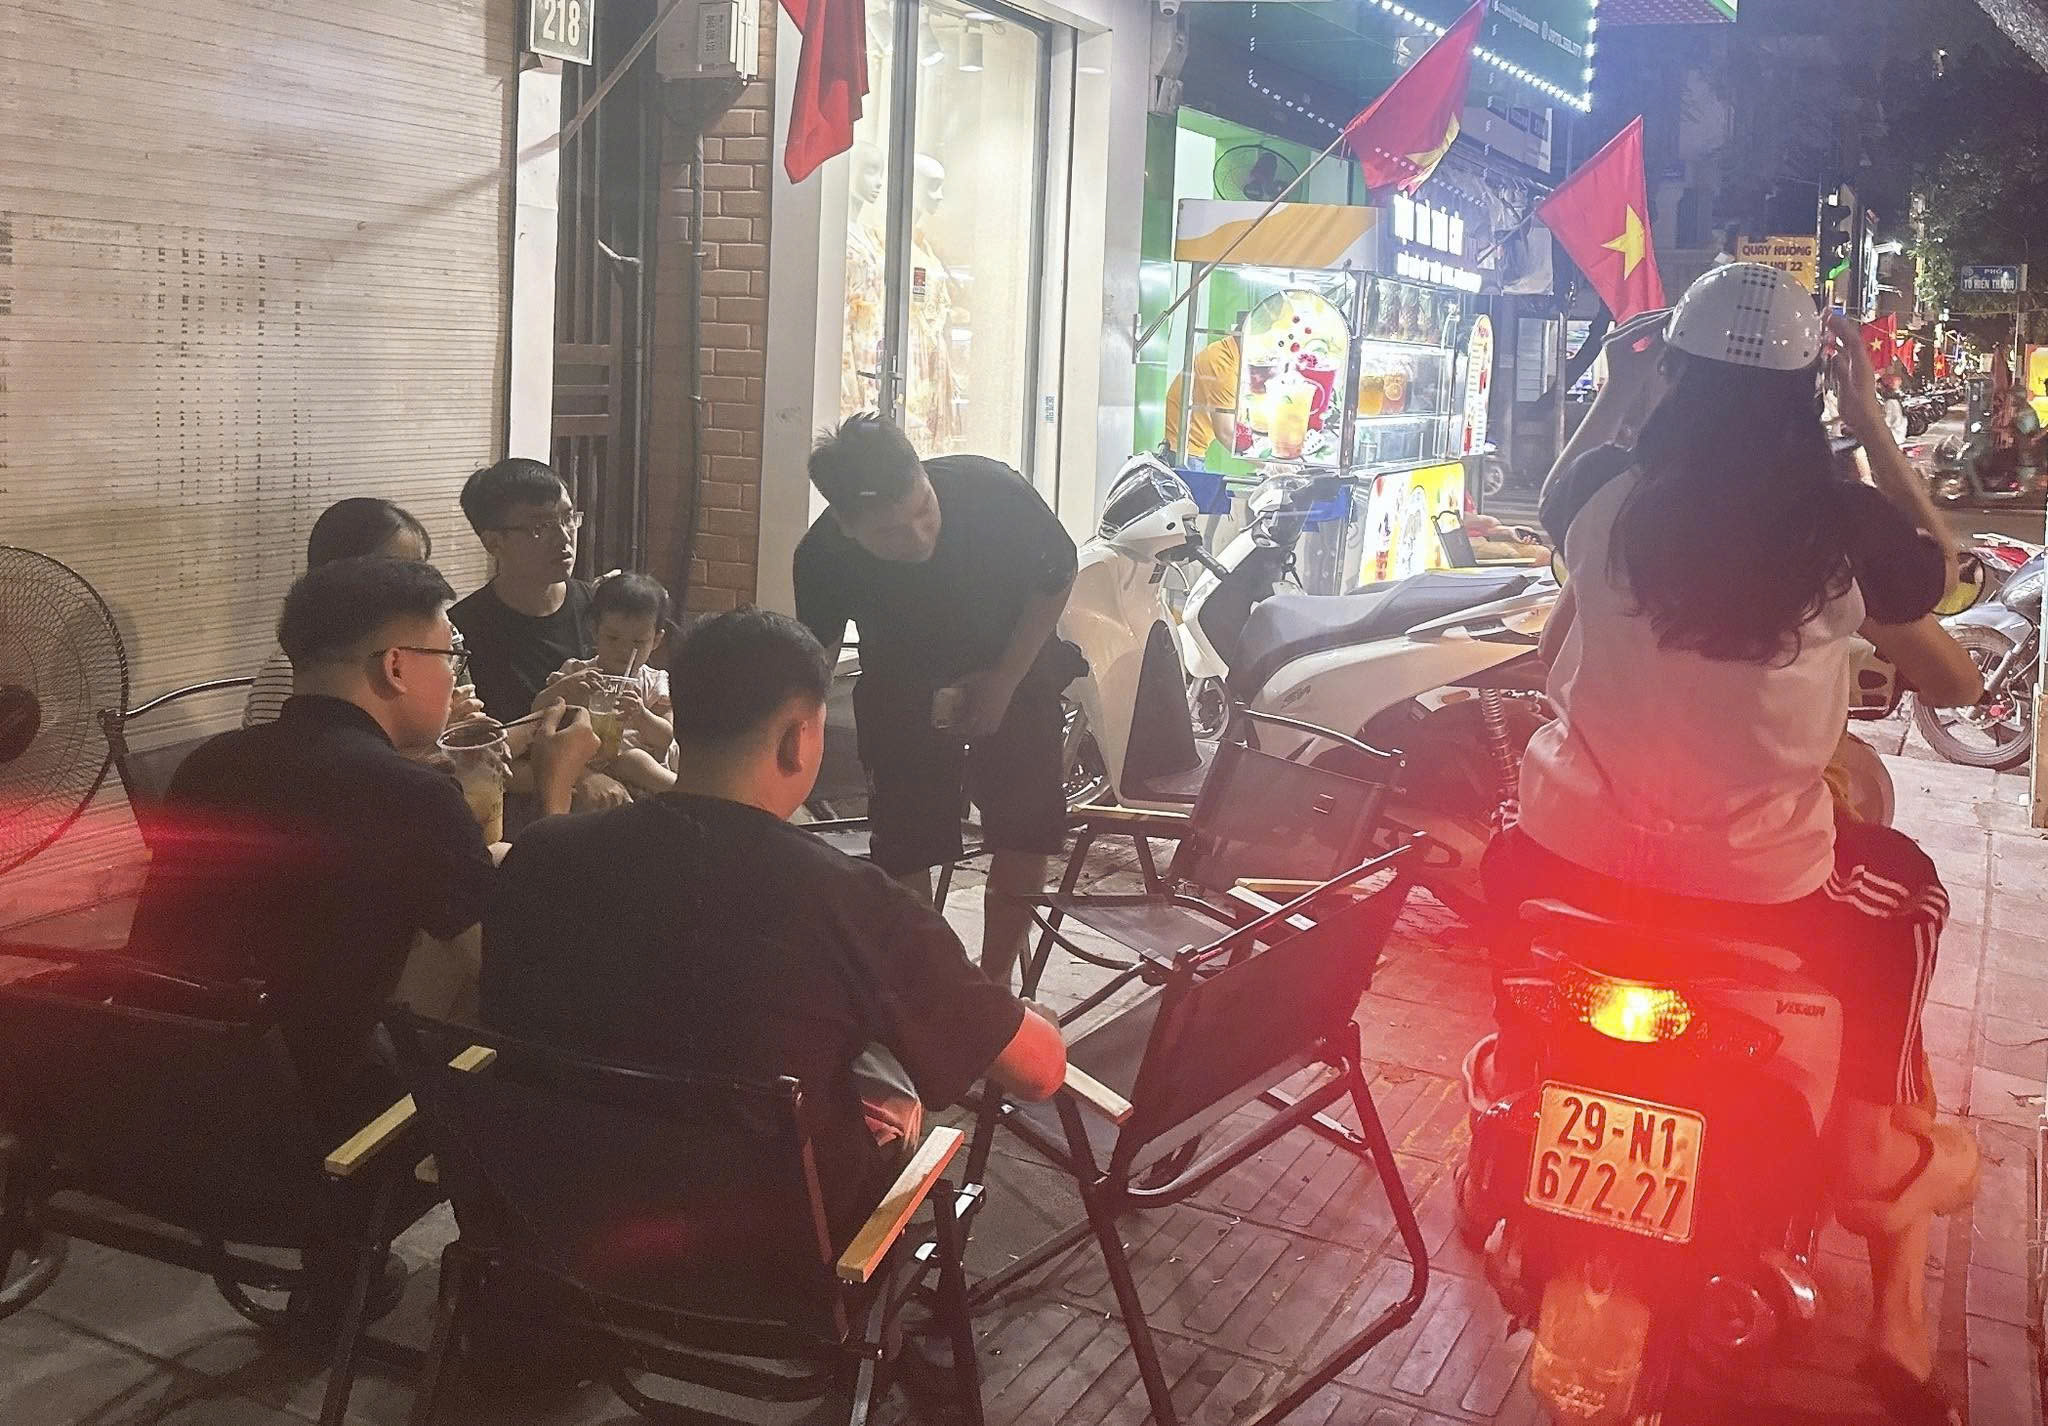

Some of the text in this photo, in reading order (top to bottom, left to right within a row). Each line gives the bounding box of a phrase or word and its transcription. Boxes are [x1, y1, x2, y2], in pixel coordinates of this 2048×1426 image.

[542, 0, 581, 46] 218
[1790, 261, 1803, 272] 22
[1557, 1096, 1676, 1169] 29-N1
[1537, 1150, 1688, 1230] 672.27
